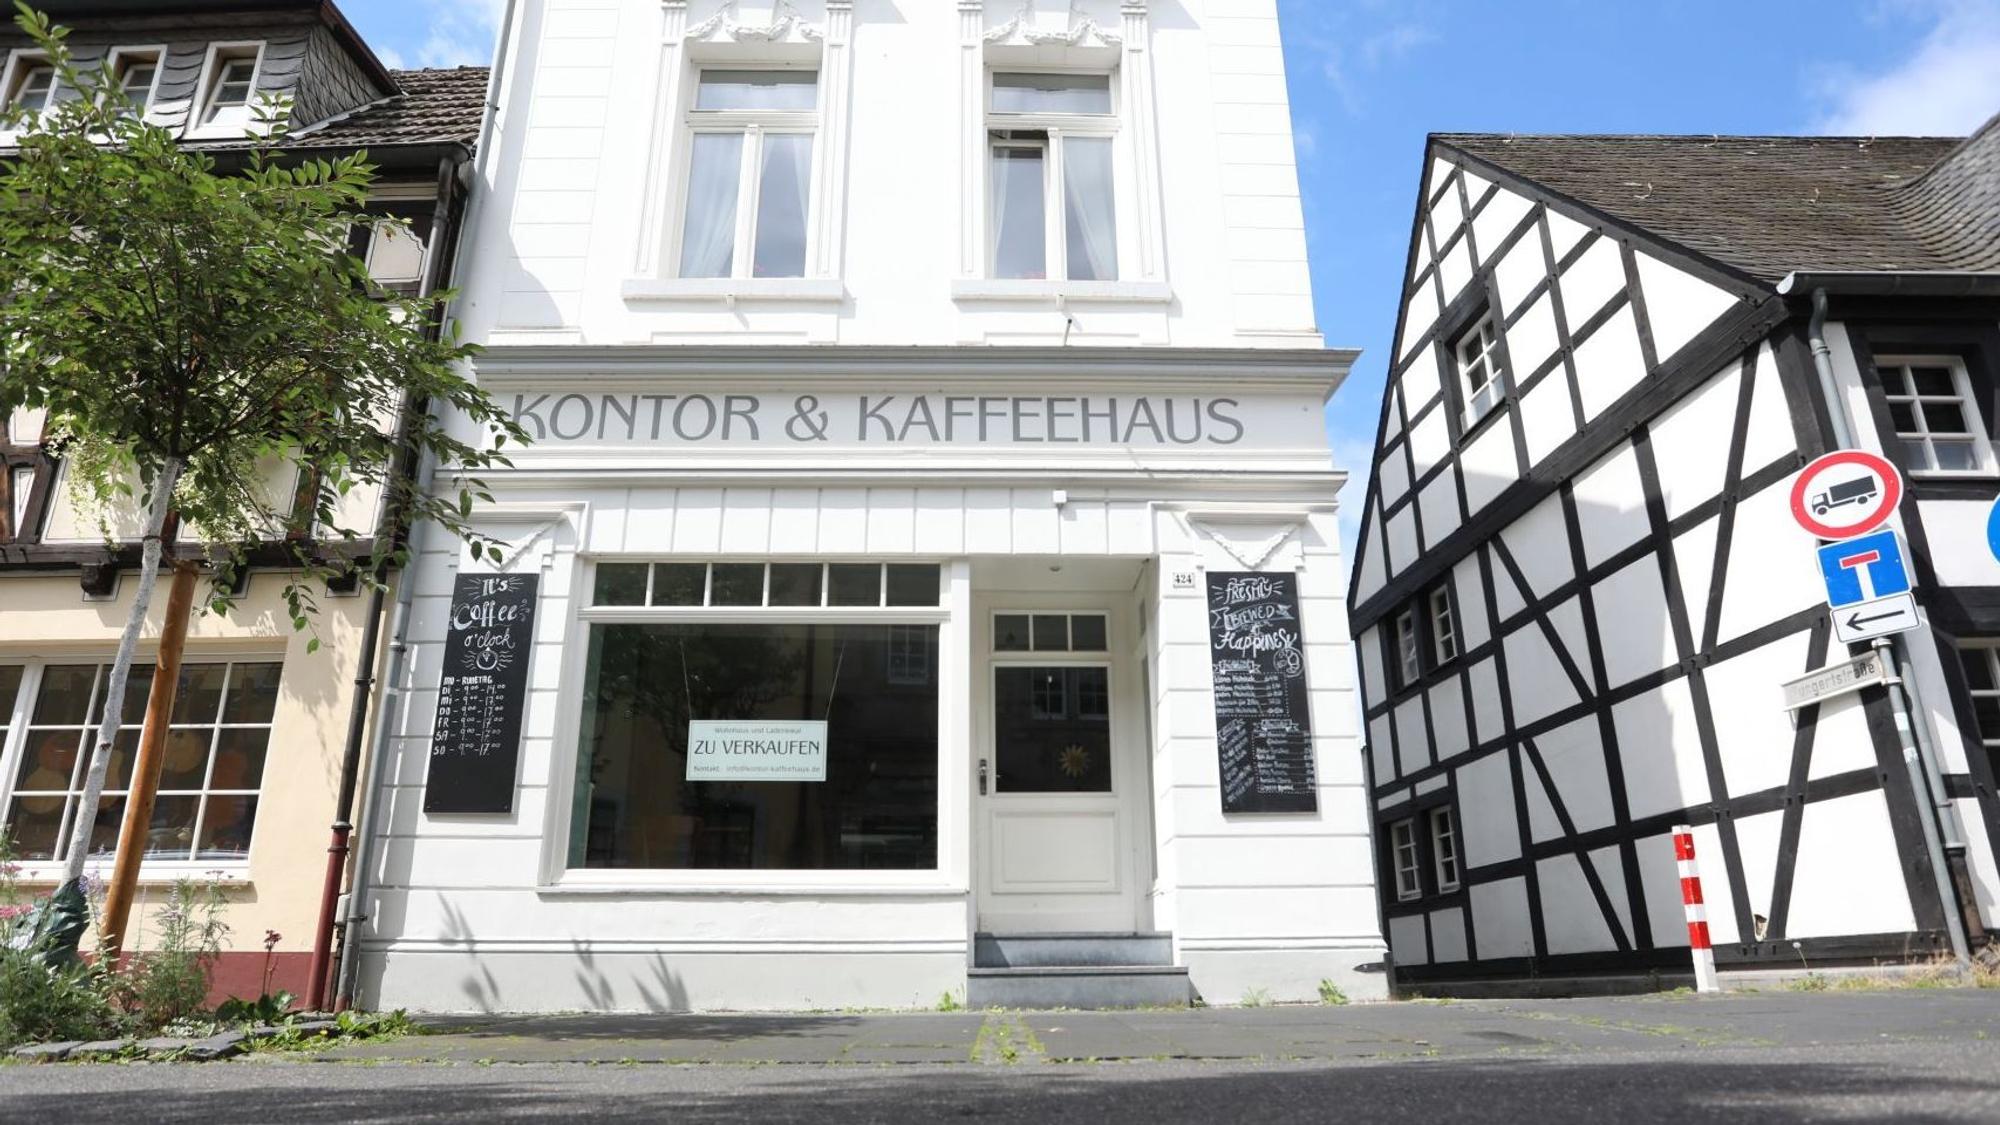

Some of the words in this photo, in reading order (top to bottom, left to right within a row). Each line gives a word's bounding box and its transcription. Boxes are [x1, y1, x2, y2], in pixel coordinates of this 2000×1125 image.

[513, 394, 760, 441] KONTOR
[785, 394, 829, 442] &
[857, 395, 1245, 444] KAFFEEHAUS
[482, 577, 509, 597] It's
[1174, 574, 1192, 584] 424
[453, 600, 518, 630] Coffee
[464, 627, 516, 649] o'clock
[694, 740, 716, 755] ZU
[722, 740, 820, 755] VERKAUFEN
